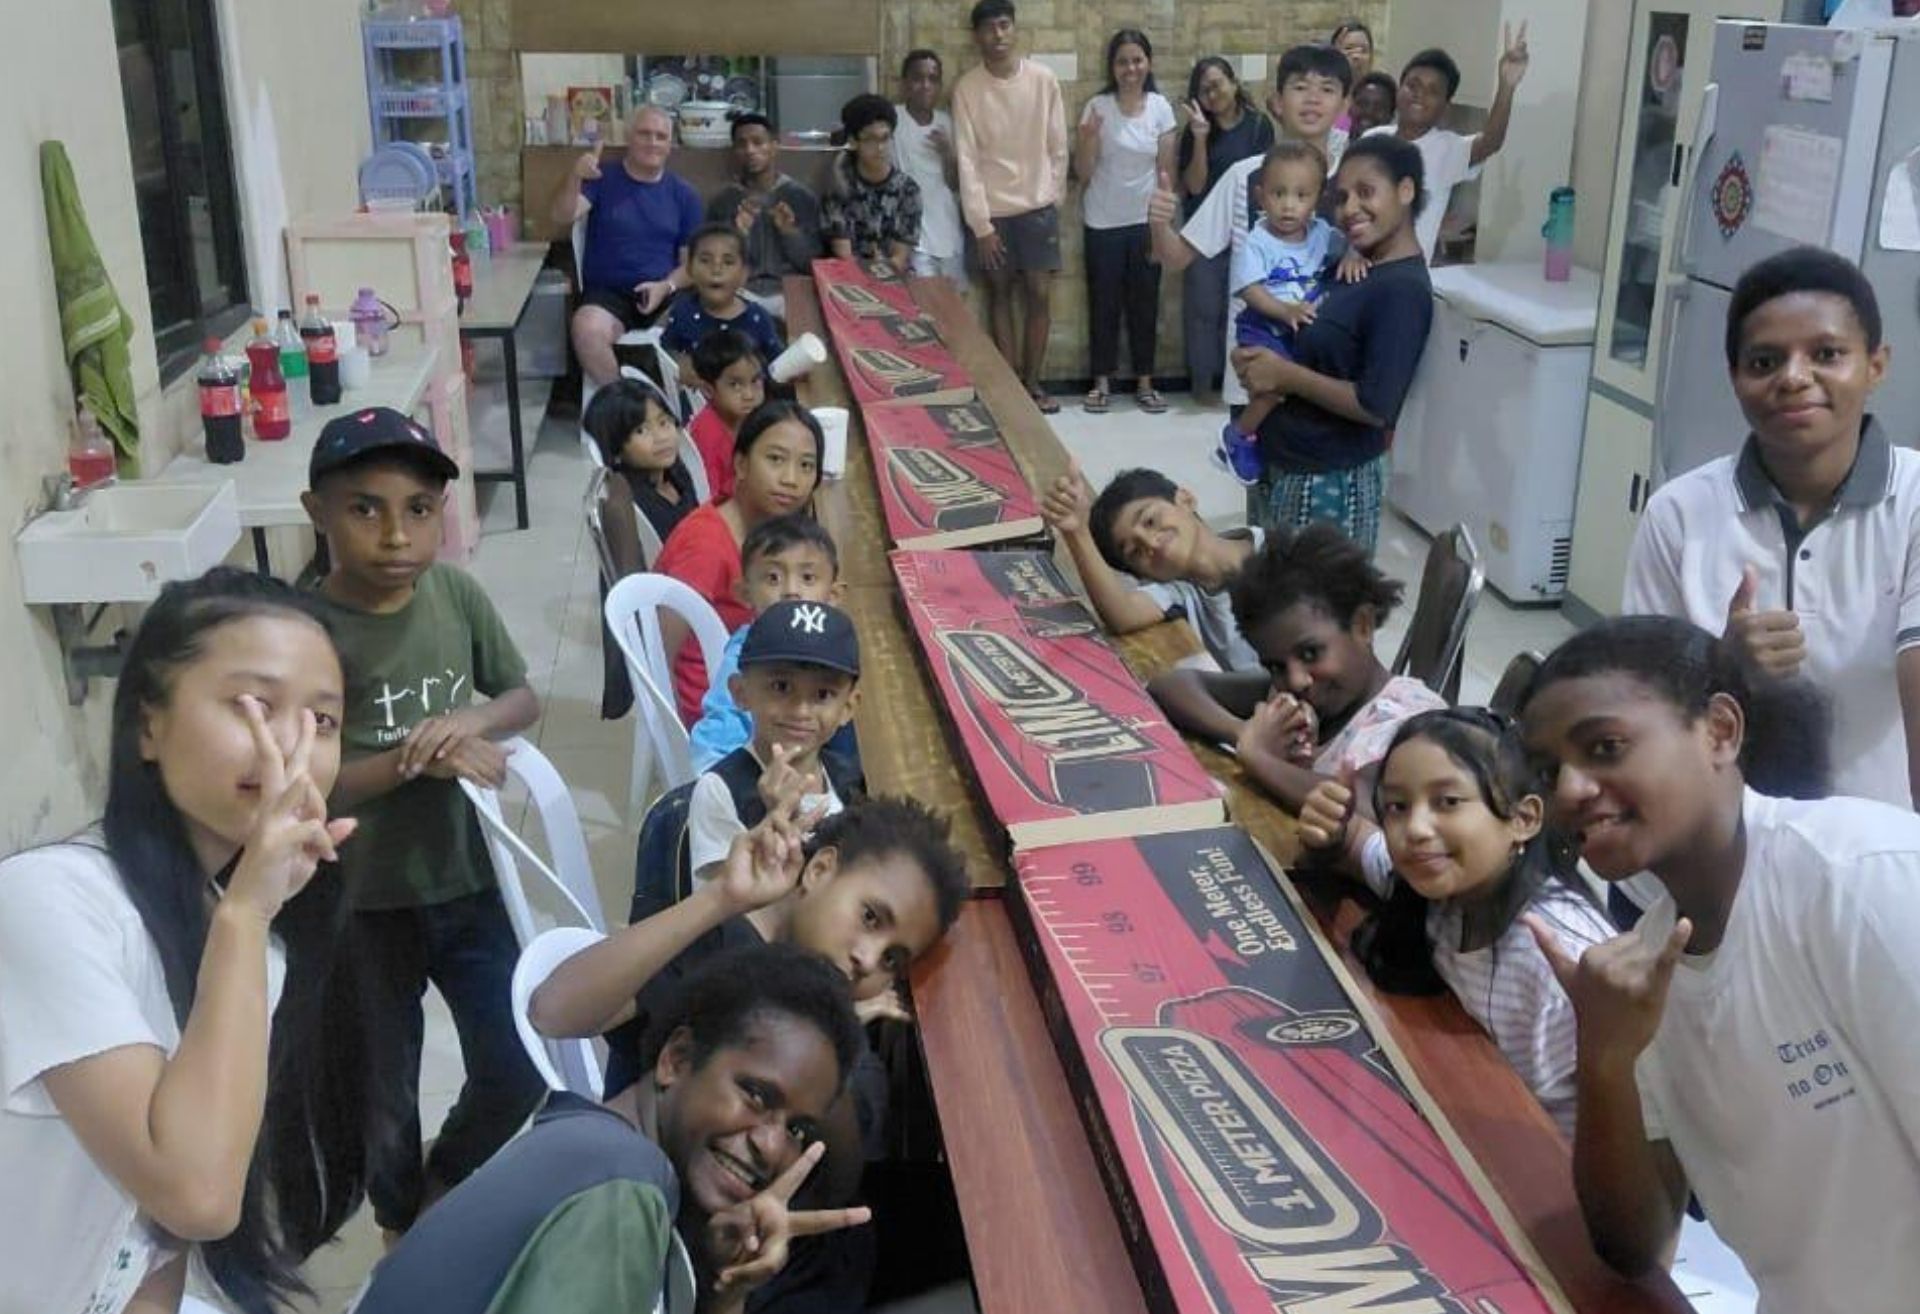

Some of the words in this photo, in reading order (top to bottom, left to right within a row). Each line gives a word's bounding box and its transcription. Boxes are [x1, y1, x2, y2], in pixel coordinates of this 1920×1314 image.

[790, 604, 827, 633] NY
[1196, 847, 1245, 885] Fun!
[1188, 866, 1239, 919] Meter,
[1227, 918, 1266, 955] One
[1232, 884, 1299, 951] Endless
[1160, 1045, 1223, 1097] PIZZA
[1202, 1100, 1294, 1185] METER
[1270, 1188, 1317, 1211] 1
